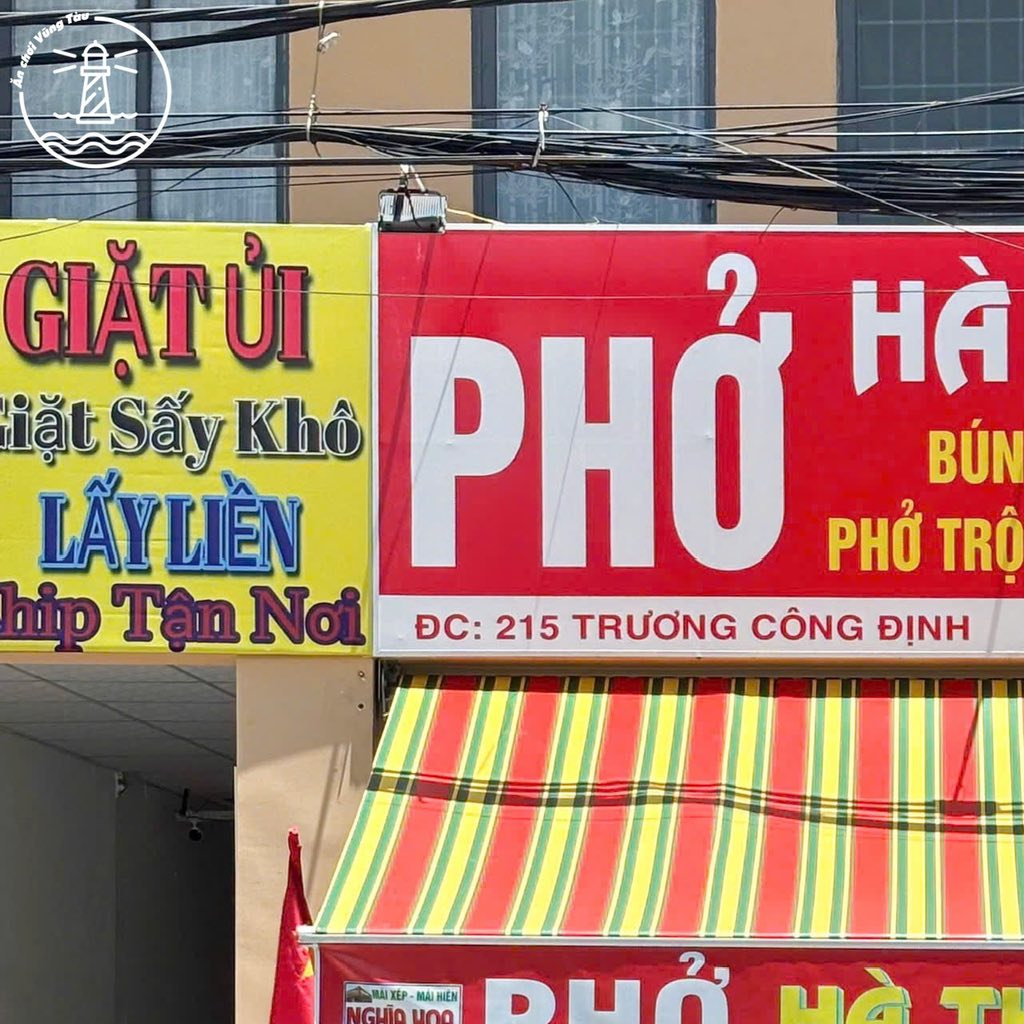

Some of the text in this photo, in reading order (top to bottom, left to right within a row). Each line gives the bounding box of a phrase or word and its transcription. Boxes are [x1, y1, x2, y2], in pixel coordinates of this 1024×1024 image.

[3, 232, 311, 382] GIẶT ỦI
[851, 256, 1012, 396] HÀ
[109, 390, 224, 472] Sấy
[234, 396, 362, 457] Khô
[411, 252, 792, 571] PHỞ
[928, 418, 1023, 485] BÚN
[39, 470, 303, 575] LẤY LIỀN
[827, 499, 923, 573] PHỞ
[111, 583, 241, 653] Tận
[249, 586, 367, 646] Nơi
[415, 606, 971, 647] ĐC: 215 TRƯƠNG CÔNG ĐỊNH
